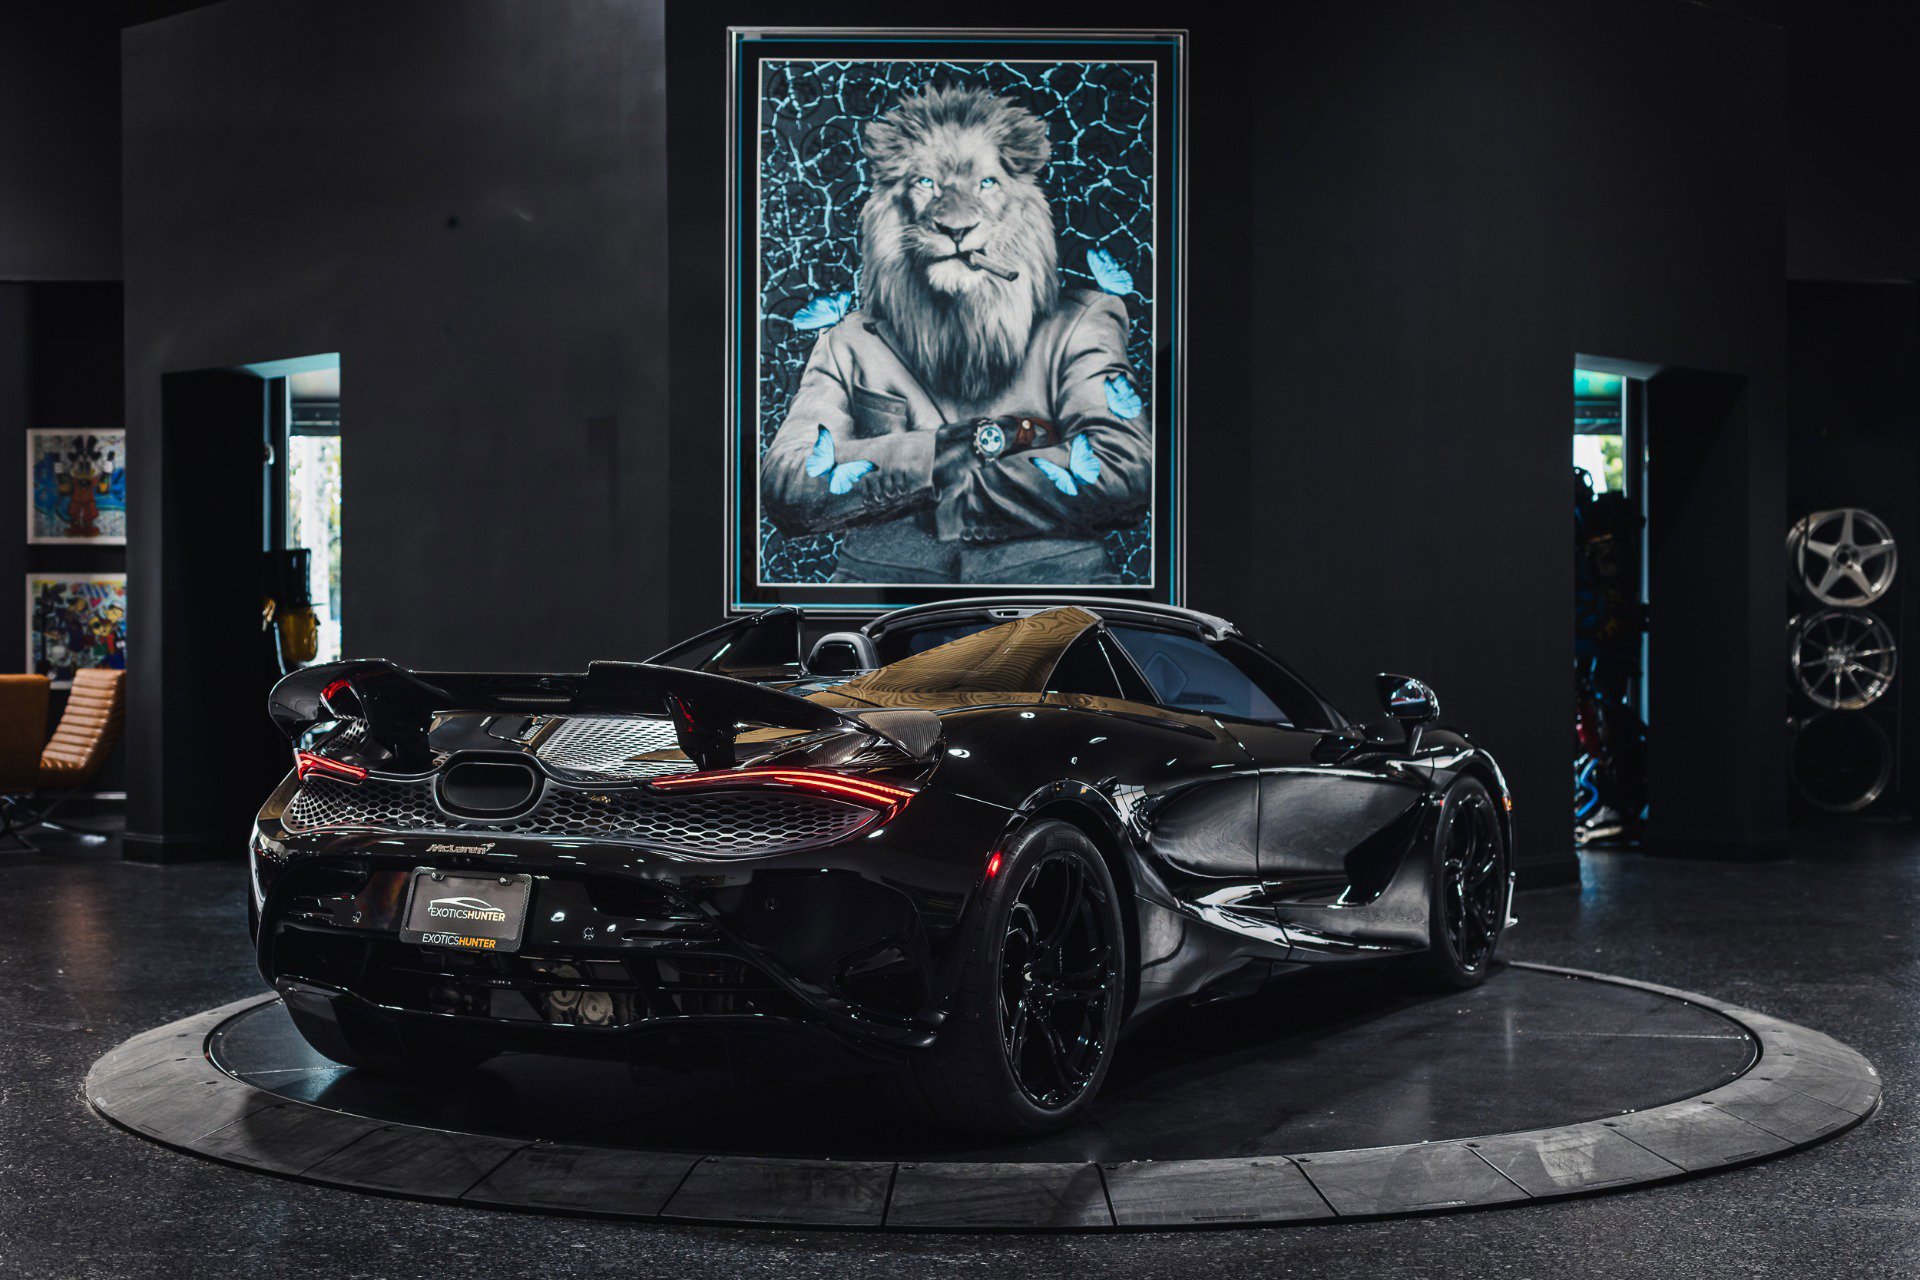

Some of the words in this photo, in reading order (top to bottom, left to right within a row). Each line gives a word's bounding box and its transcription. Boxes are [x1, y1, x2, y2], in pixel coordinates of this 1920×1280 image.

[426, 844, 486, 855] McLaren
[430, 907, 506, 922] EXOTICSHUNTER
[422, 933, 497, 949] EXOTICSHUNTER
